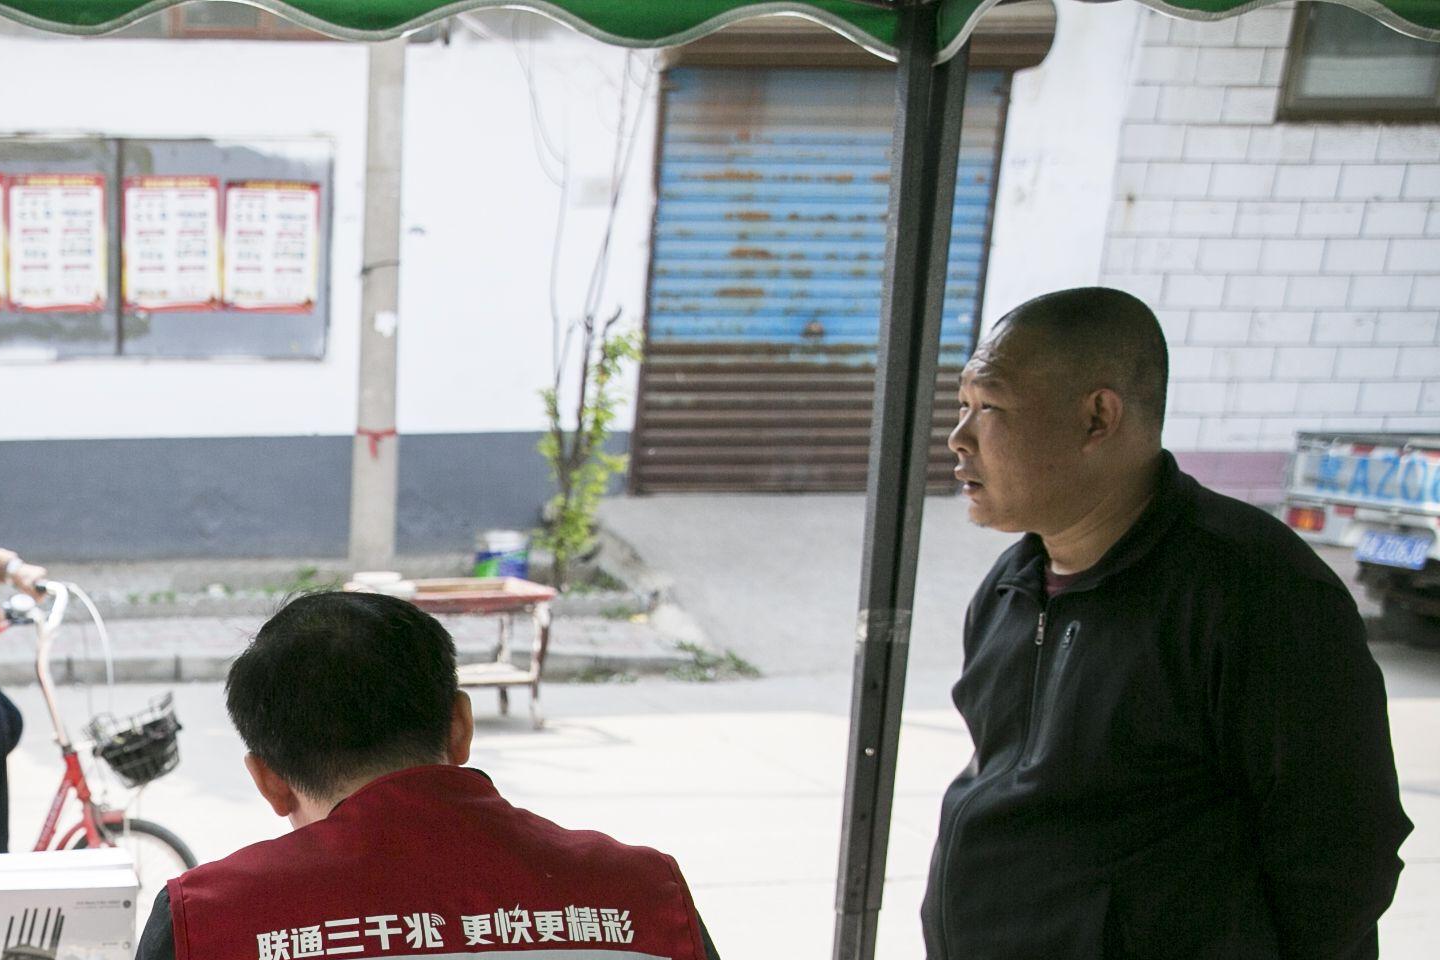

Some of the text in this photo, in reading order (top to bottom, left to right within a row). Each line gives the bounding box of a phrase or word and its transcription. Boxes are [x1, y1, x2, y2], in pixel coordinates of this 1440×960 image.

[460, 904, 636, 945] 更快更精彩
